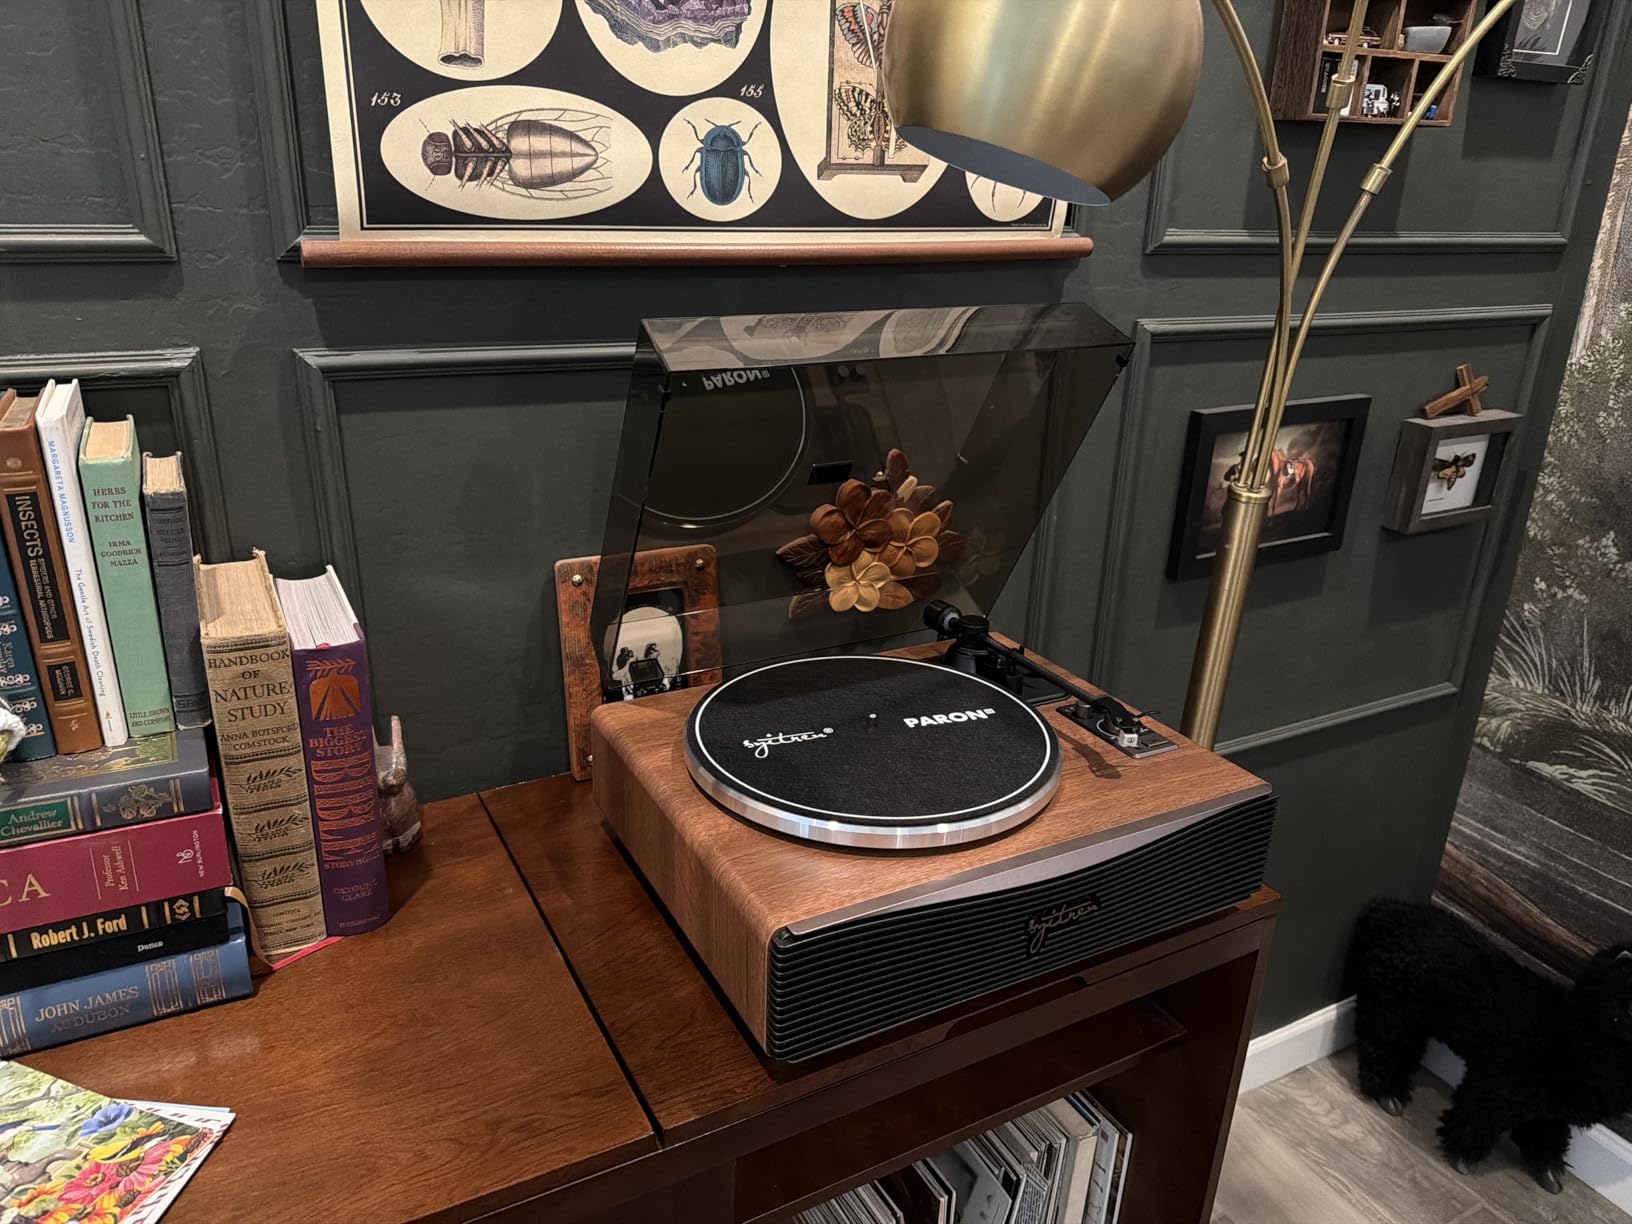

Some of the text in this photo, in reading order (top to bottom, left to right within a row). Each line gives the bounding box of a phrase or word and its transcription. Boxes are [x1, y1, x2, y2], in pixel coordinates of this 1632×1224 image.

[370, 91, 402, 107] 153
[740, 83, 765, 98] 155
[48, 440, 75, 543] MARGARETA MAGNUSSON
[93, 487, 127, 496] HERBS
[92, 500, 132, 510] FOR THE
[15, 495, 43, 557] INSECTS
[94, 512, 135, 523] KITCHEN
[108, 540, 131, 548] IRMA
[101, 549, 142, 558] GOODRICH
[110, 559, 138, 567] MAZZA
[78, 582, 88, 604] Gentle
[92, 651, 102, 669] Death
[208, 648, 289, 668] HANDBOOK
[242, 670, 260, 679] OF
[213, 681, 290, 703] NATURE
[227, 701, 288, 722] STUDY
[903, 709, 988, 728] PARON
[220, 723, 298, 741] ANNA BOTSFORD
[325, 725, 353, 737] THE
[233, 736, 289, 750] COMSTOCK
[316, 742, 362, 757] STORY
[311, 751, 377, 861] BIBLE
[8, 809, 57, 825] Andrew
[0, 820, 64, 837] Chevallier
[192, 829, 204, 864] BURLINGTON
[102, 854, 115, 888] Professor
[111, 844, 129, 891] Ken Ashwell
[31, 914, 128, 950] Robert J. Ford
[35, 985, 140, 1022] JOHN JAMES
[51, 1003, 131, 1033] AUDUBON
